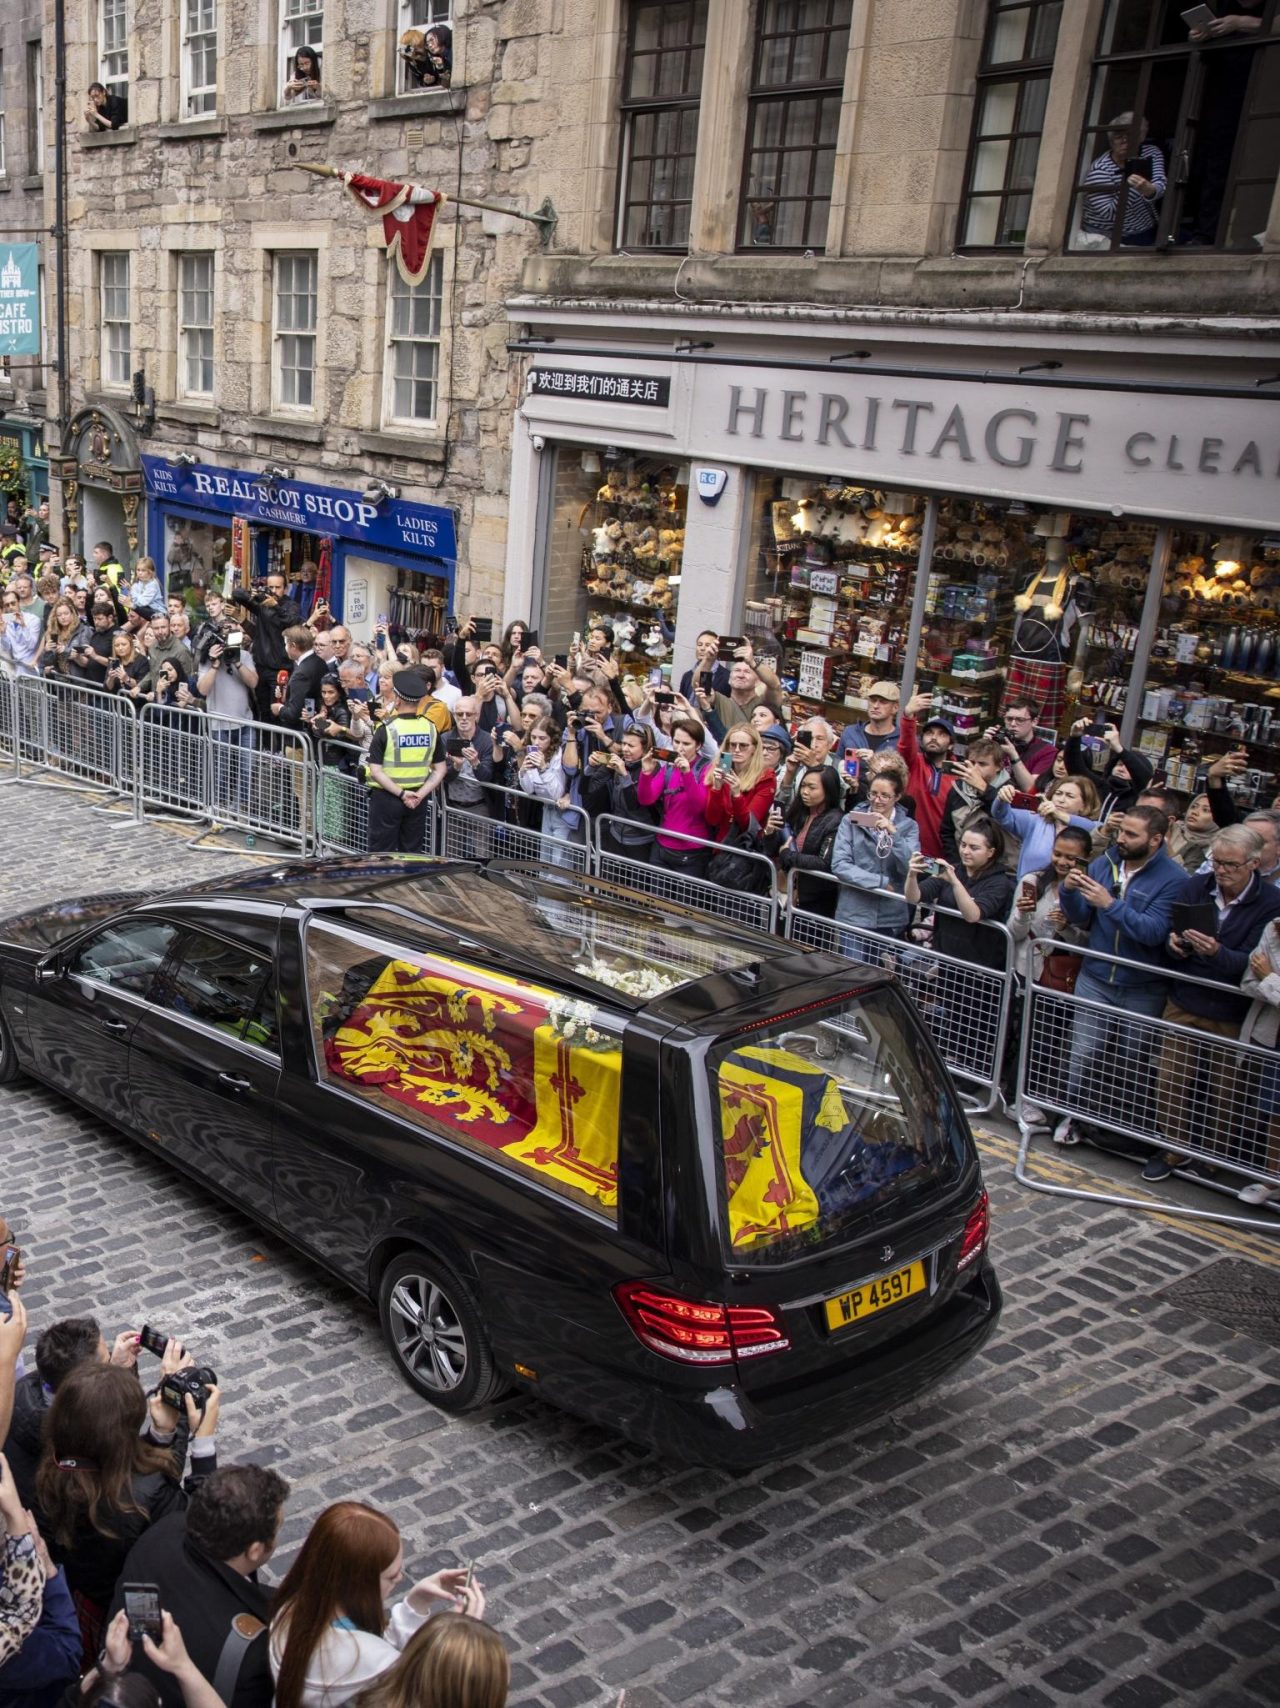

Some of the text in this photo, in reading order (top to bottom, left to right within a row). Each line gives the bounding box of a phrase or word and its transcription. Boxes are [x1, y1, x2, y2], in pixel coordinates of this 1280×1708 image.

[539, 371, 659, 400] 欢迎到我们的通关店
[725, 384, 1280, 479] HERITAGE CLEA
[153, 468, 173, 481] KIDS
[700, 473, 716, 484] RG
[154, 480, 177, 494] KILTS
[192, 472, 378, 527] REAL SCOT SHOP
[258, 505, 307, 525] CASHMERE
[396, 515, 438, 533] LADIES
[402, 530, 436, 548] KILTS
[400, 735, 430, 747] POLICE
[839, 1268, 912, 1321] WP 4597
